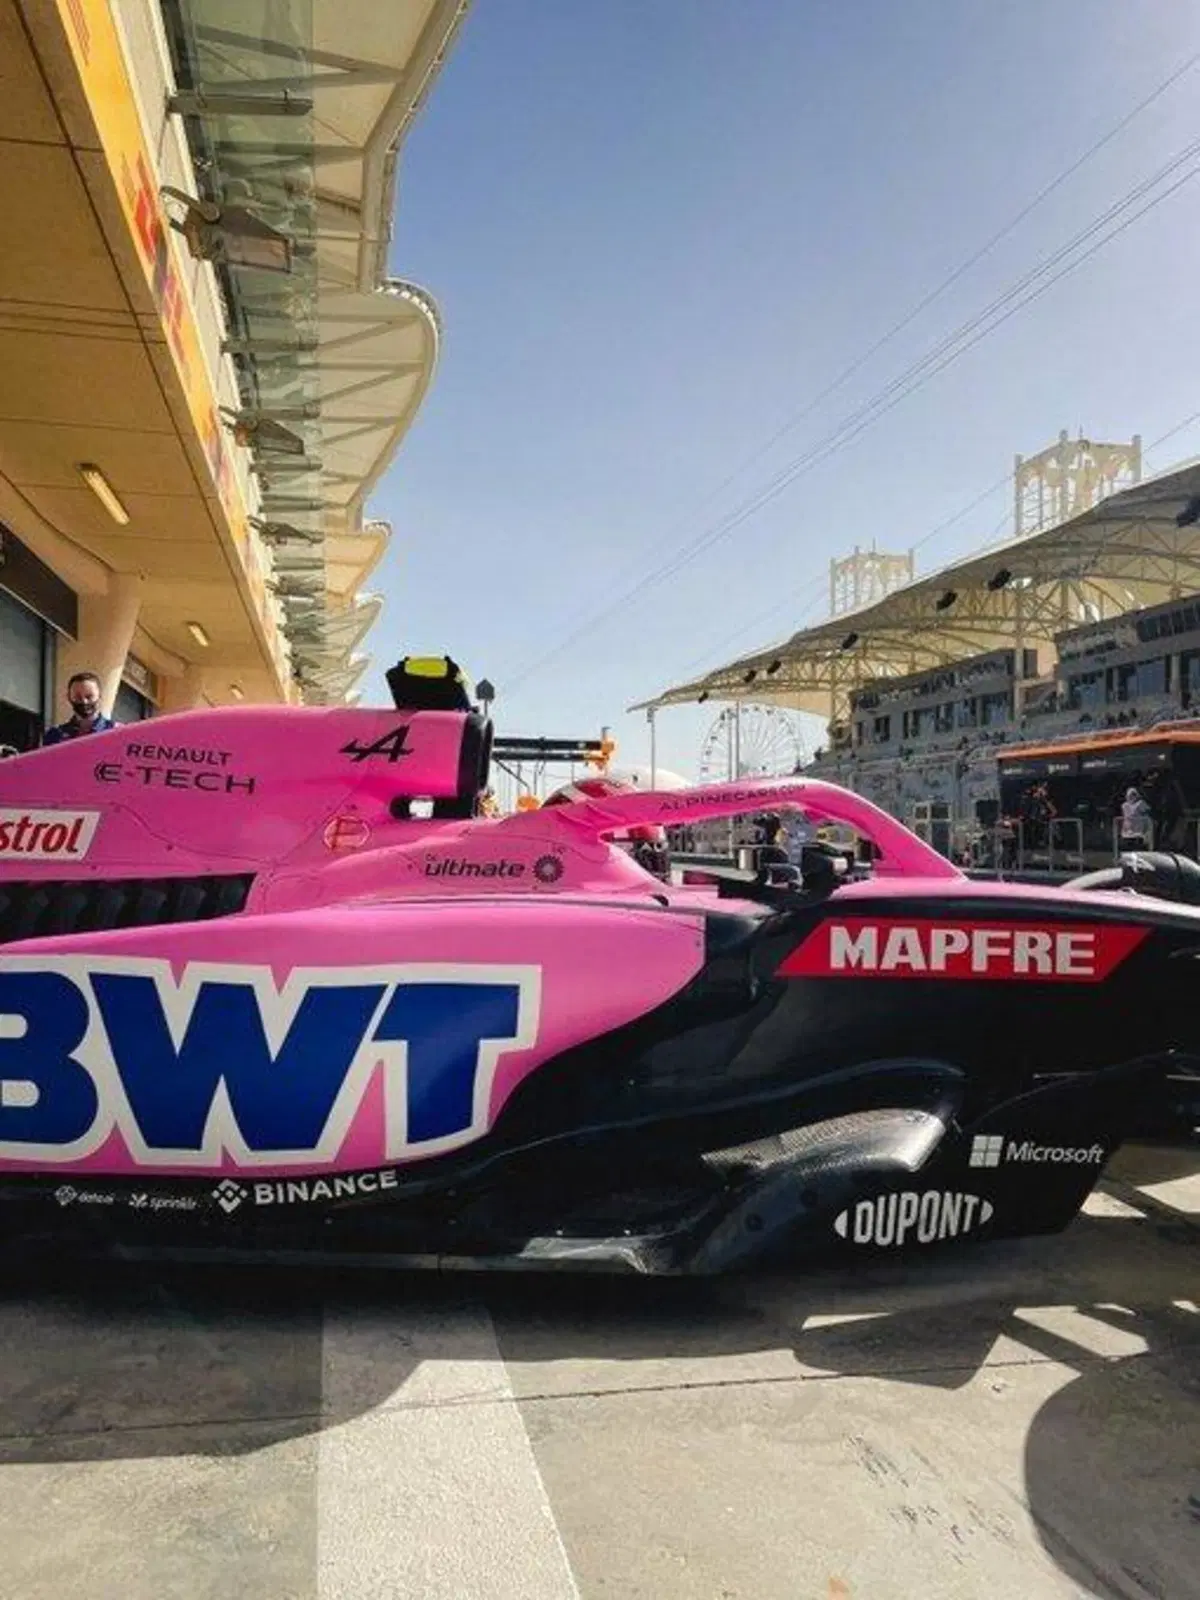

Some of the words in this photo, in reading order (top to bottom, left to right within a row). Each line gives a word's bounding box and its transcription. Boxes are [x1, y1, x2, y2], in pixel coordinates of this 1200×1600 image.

[127, 743, 232, 766] RENAULT
[425, 857, 525, 878] ultimate
[829, 926, 1095, 975] MAPFRE
[0, 971, 521, 1151] BWT
[1006, 1141, 1104, 1164] Microsoft
[253, 1169, 398, 1205] BINANCE
[853, 1191, 980, 1246] DUPONT
